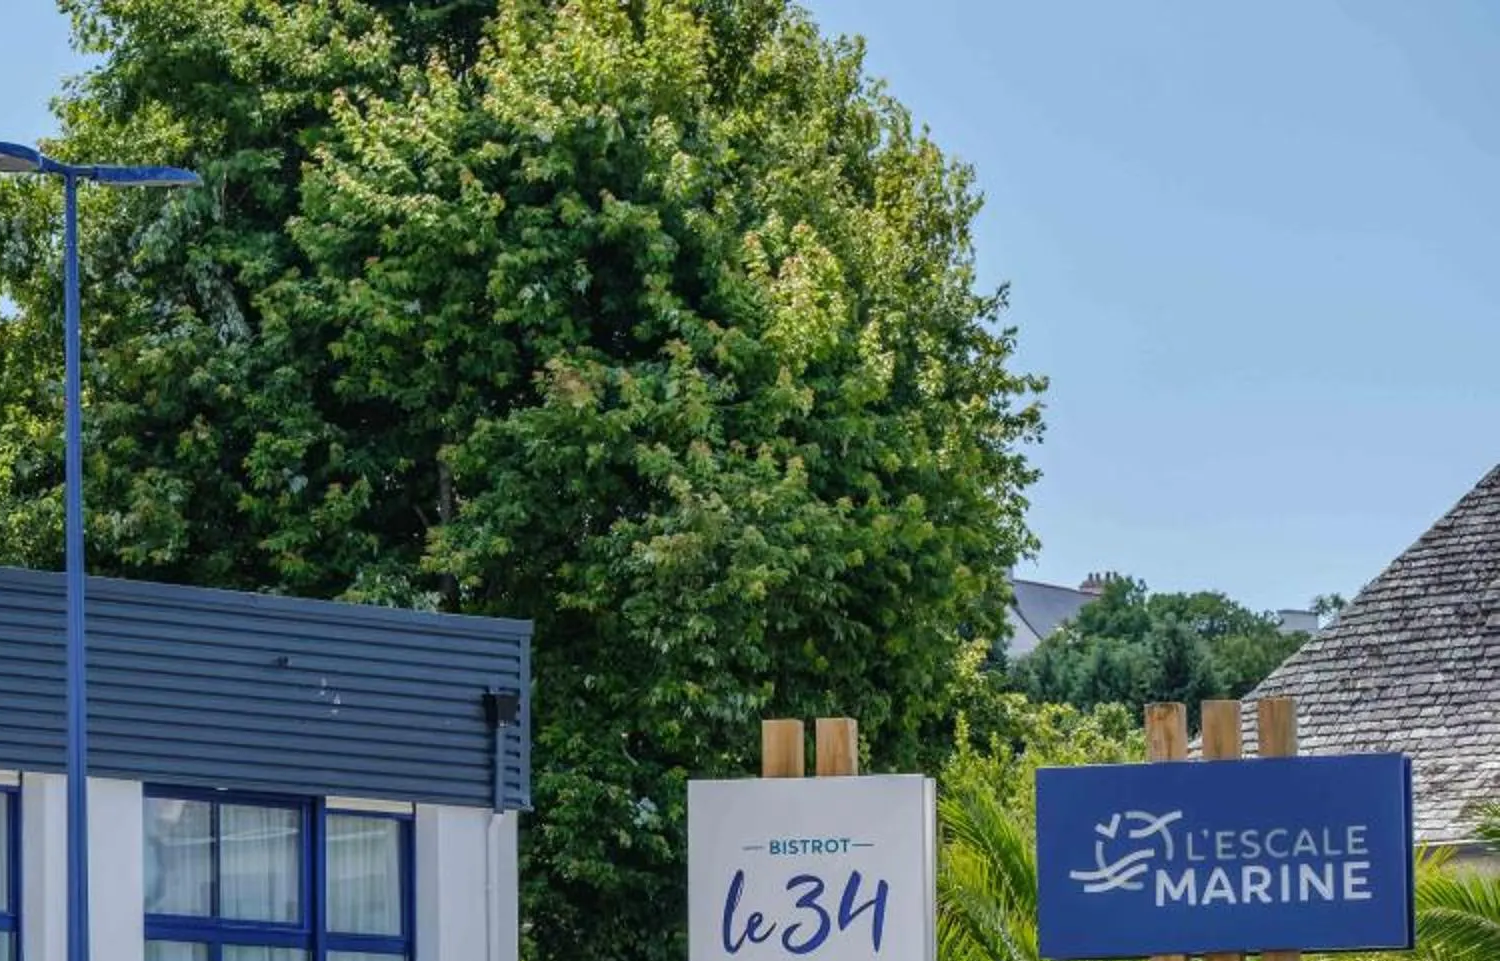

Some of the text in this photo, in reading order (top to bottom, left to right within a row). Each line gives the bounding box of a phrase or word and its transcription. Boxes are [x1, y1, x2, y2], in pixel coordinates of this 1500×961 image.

[769, 838, 852, 855] BISTROT
[1187, 825, 1369, 861] L'ESCALE
[1155, 861, 1373, 907] MARINE
[722, 869, 889, 955] le 34
